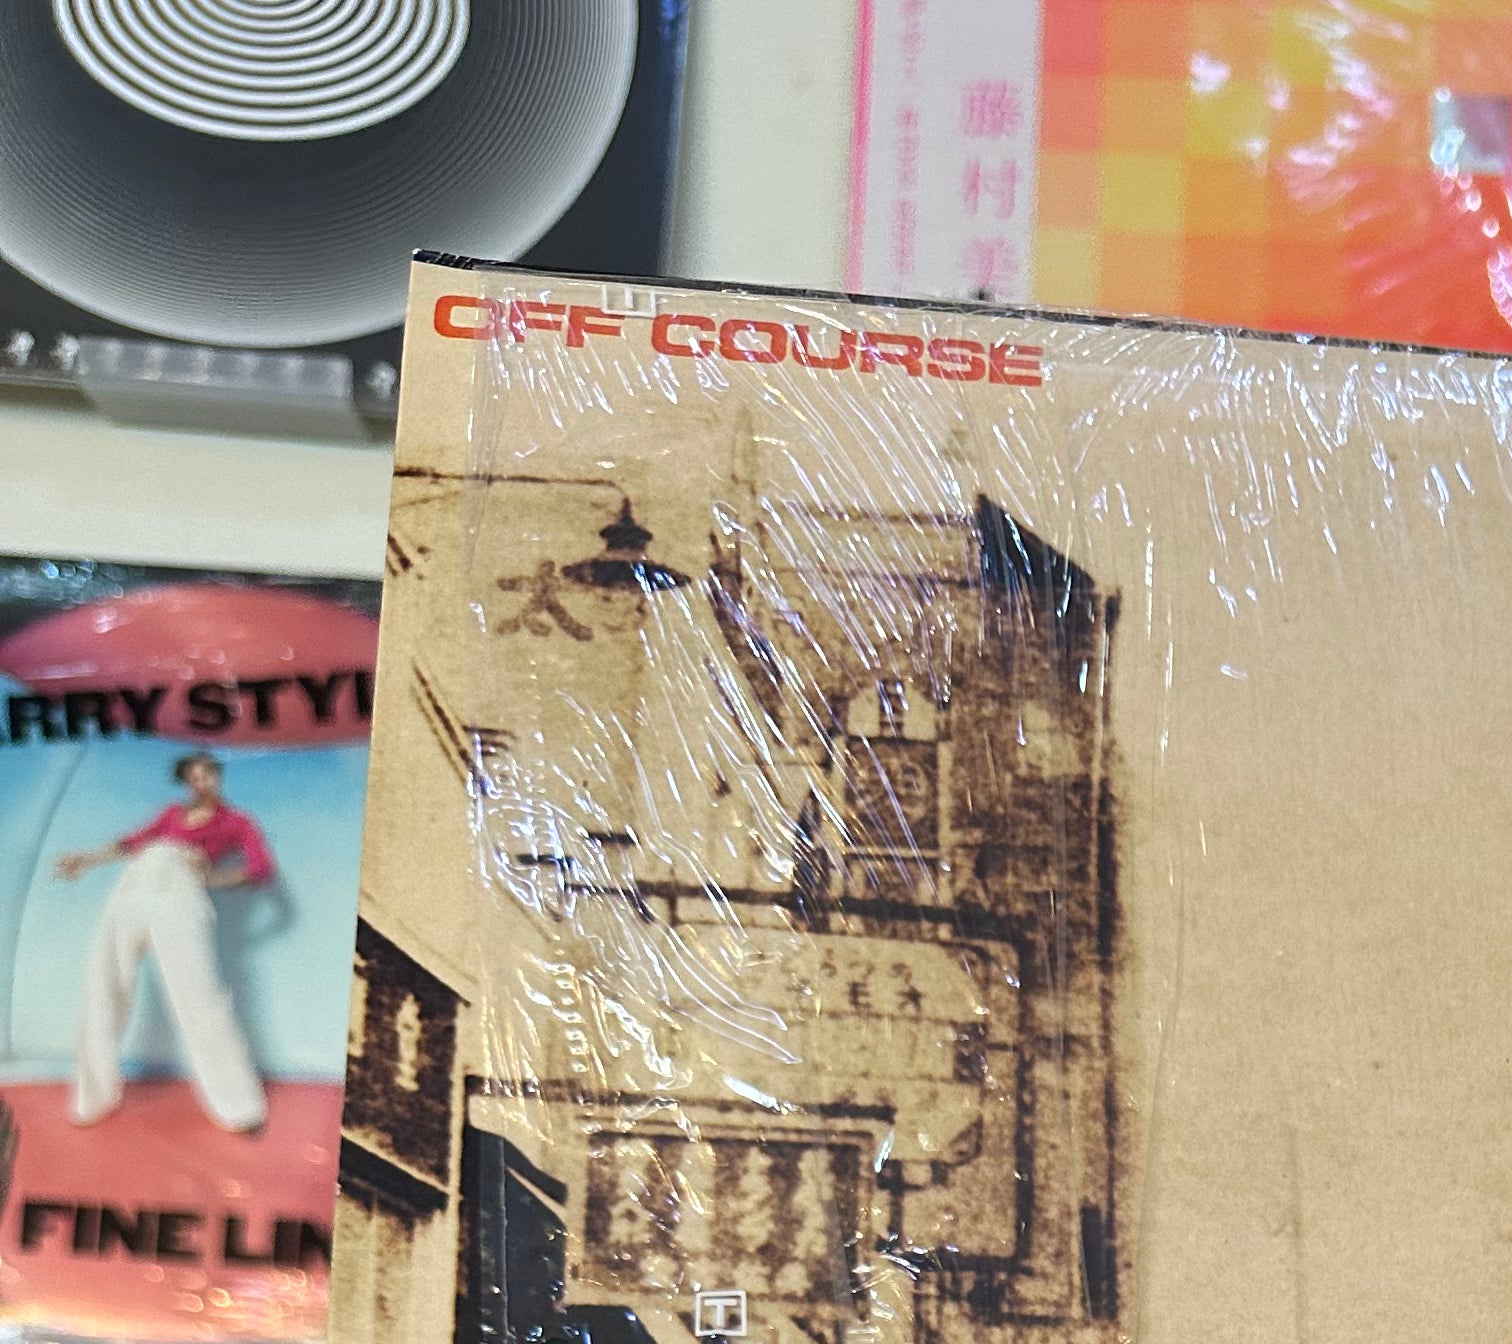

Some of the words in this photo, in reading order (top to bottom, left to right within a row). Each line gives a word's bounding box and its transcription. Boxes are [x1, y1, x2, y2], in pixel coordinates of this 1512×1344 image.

[433, 295, 625, 347] OFF
[651, 313, 1043, 387] COURSE
[0, 686, 172, 741] RRY
[22, 1200, 204, 1259] FINE
